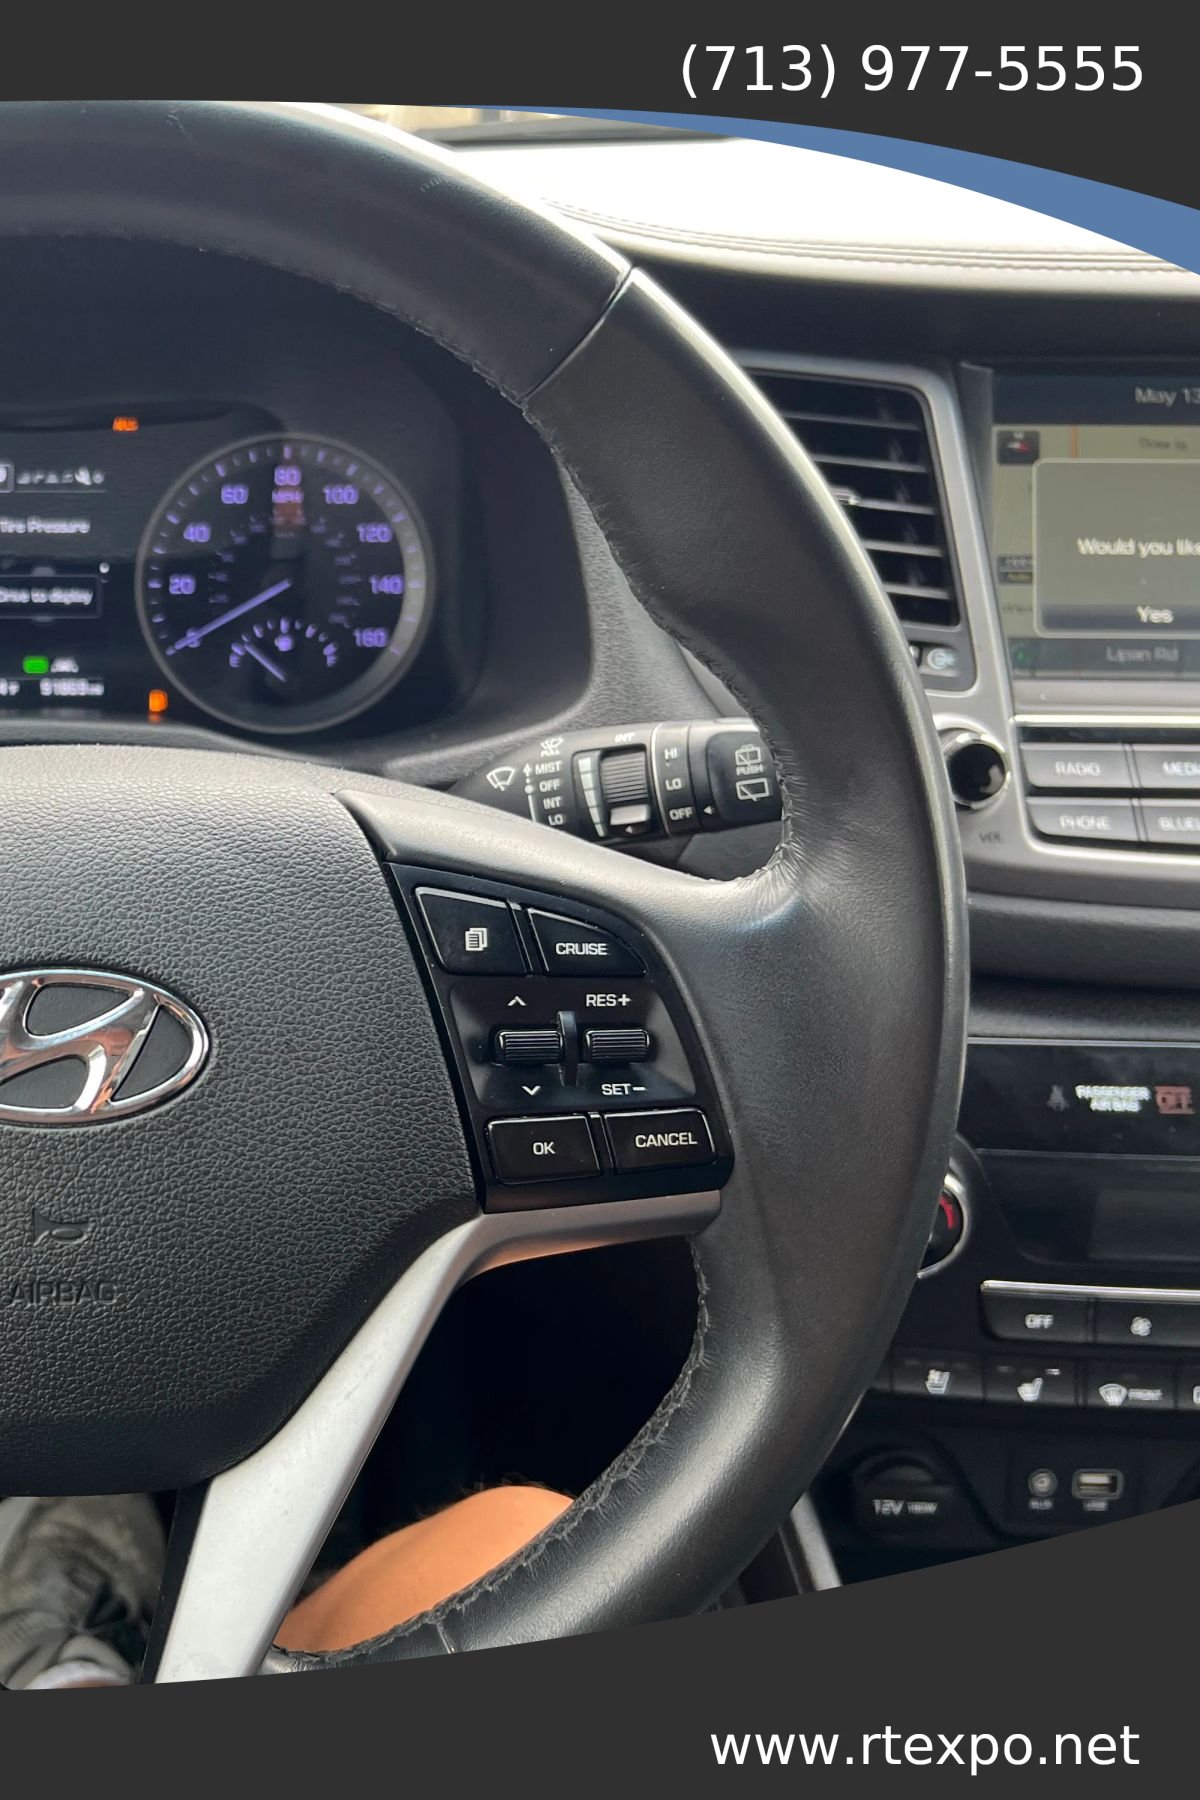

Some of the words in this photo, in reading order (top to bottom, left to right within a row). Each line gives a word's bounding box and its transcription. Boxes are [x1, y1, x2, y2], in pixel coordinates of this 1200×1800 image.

[1134, 387, 1176, 408] May
[221, 484, 249, 504] 60
[323, 485, 359, 504] 100
[27, 515, 91, 534] Pressure
[183, 522, 211, 543] 40
[356, 522, 394, 543] 120
[1077, 537, 1135, 556] Would
[1137, 541, 1173, 559] you
[169, 574, 197, 595] 20
[369, 574, 405, 595] 140
[31, 587, 49, 604] to
[49, 586, 94, 606] display
[1136, 605, 1174, 624] Yes
[353, 628, 391, 648] 160
[1106, 646, 1152, 665] Lipan
[1154, 646, 1179, 662] Rd
[664, 747, 678, 760] HI
[535, 762, 562, 774] MIST
[736, 764, 764, 776] PUSH
[1055, 761, 1101, 777] RADIO
[539, 780, 561, 793] OFF
[666, 778, 681, 791] LO
[543, 797, 561, 809] INT
[548, 813, 564, 826] LO
[669, 808, 693, 821] OFF
[1060, 816, 1111, 831] PHONE
[556, 942, 608, 956] CRUISE
[533, 1142, 555, 1155] OK
[635, 1132, 698, 1148] CANCEL
[10, 1280, 118, 1306] AIRBAG
[1025, 1314, 1054, 1329] OFF
